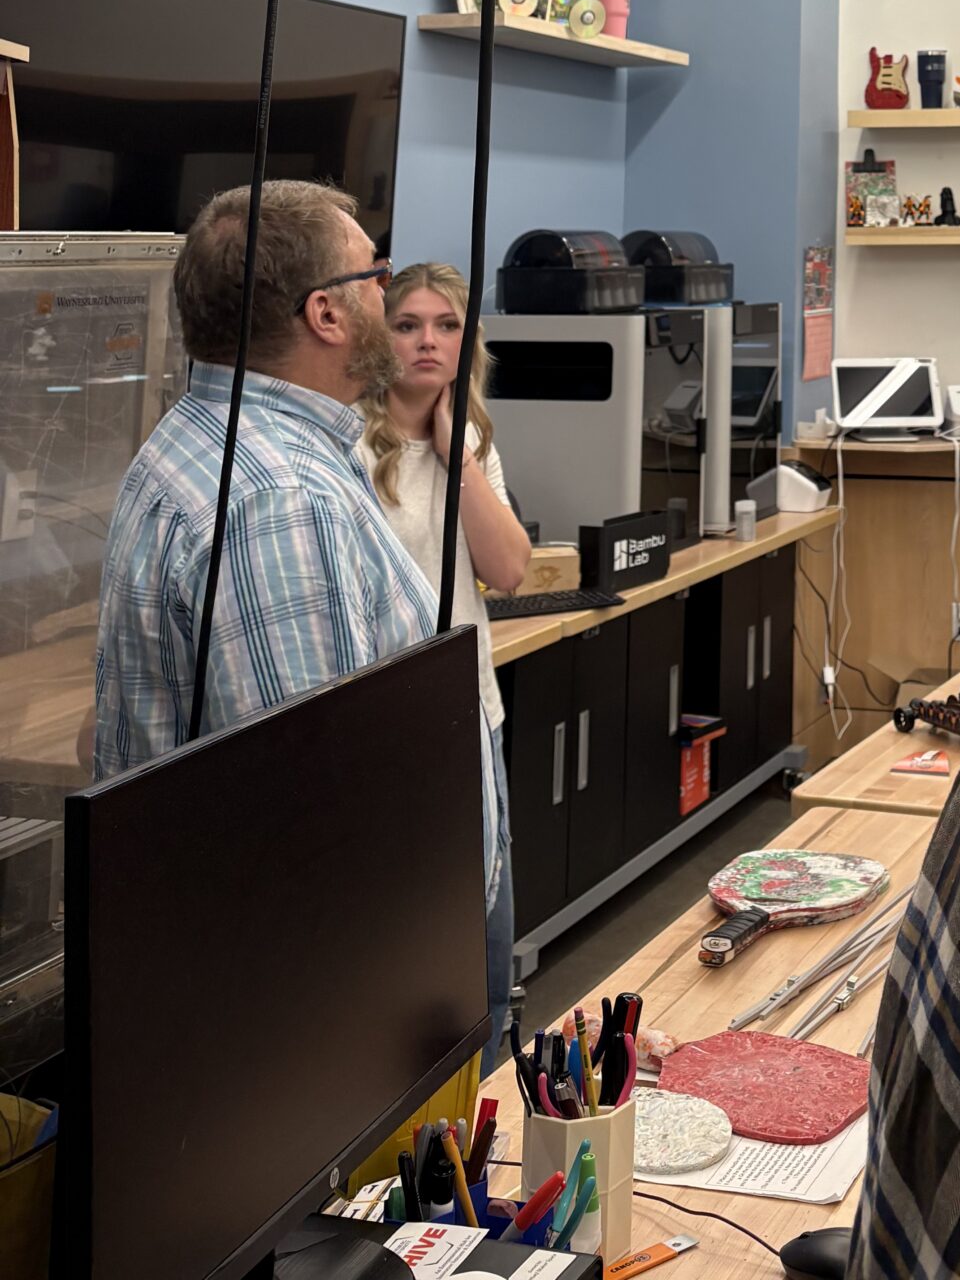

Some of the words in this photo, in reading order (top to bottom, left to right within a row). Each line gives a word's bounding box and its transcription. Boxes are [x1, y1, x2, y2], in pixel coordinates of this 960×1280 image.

[628, 534, 666, 554] Bambu
[628, 552, 650, 568] Lab
[403, 1227, 448, 1267] HIVE
